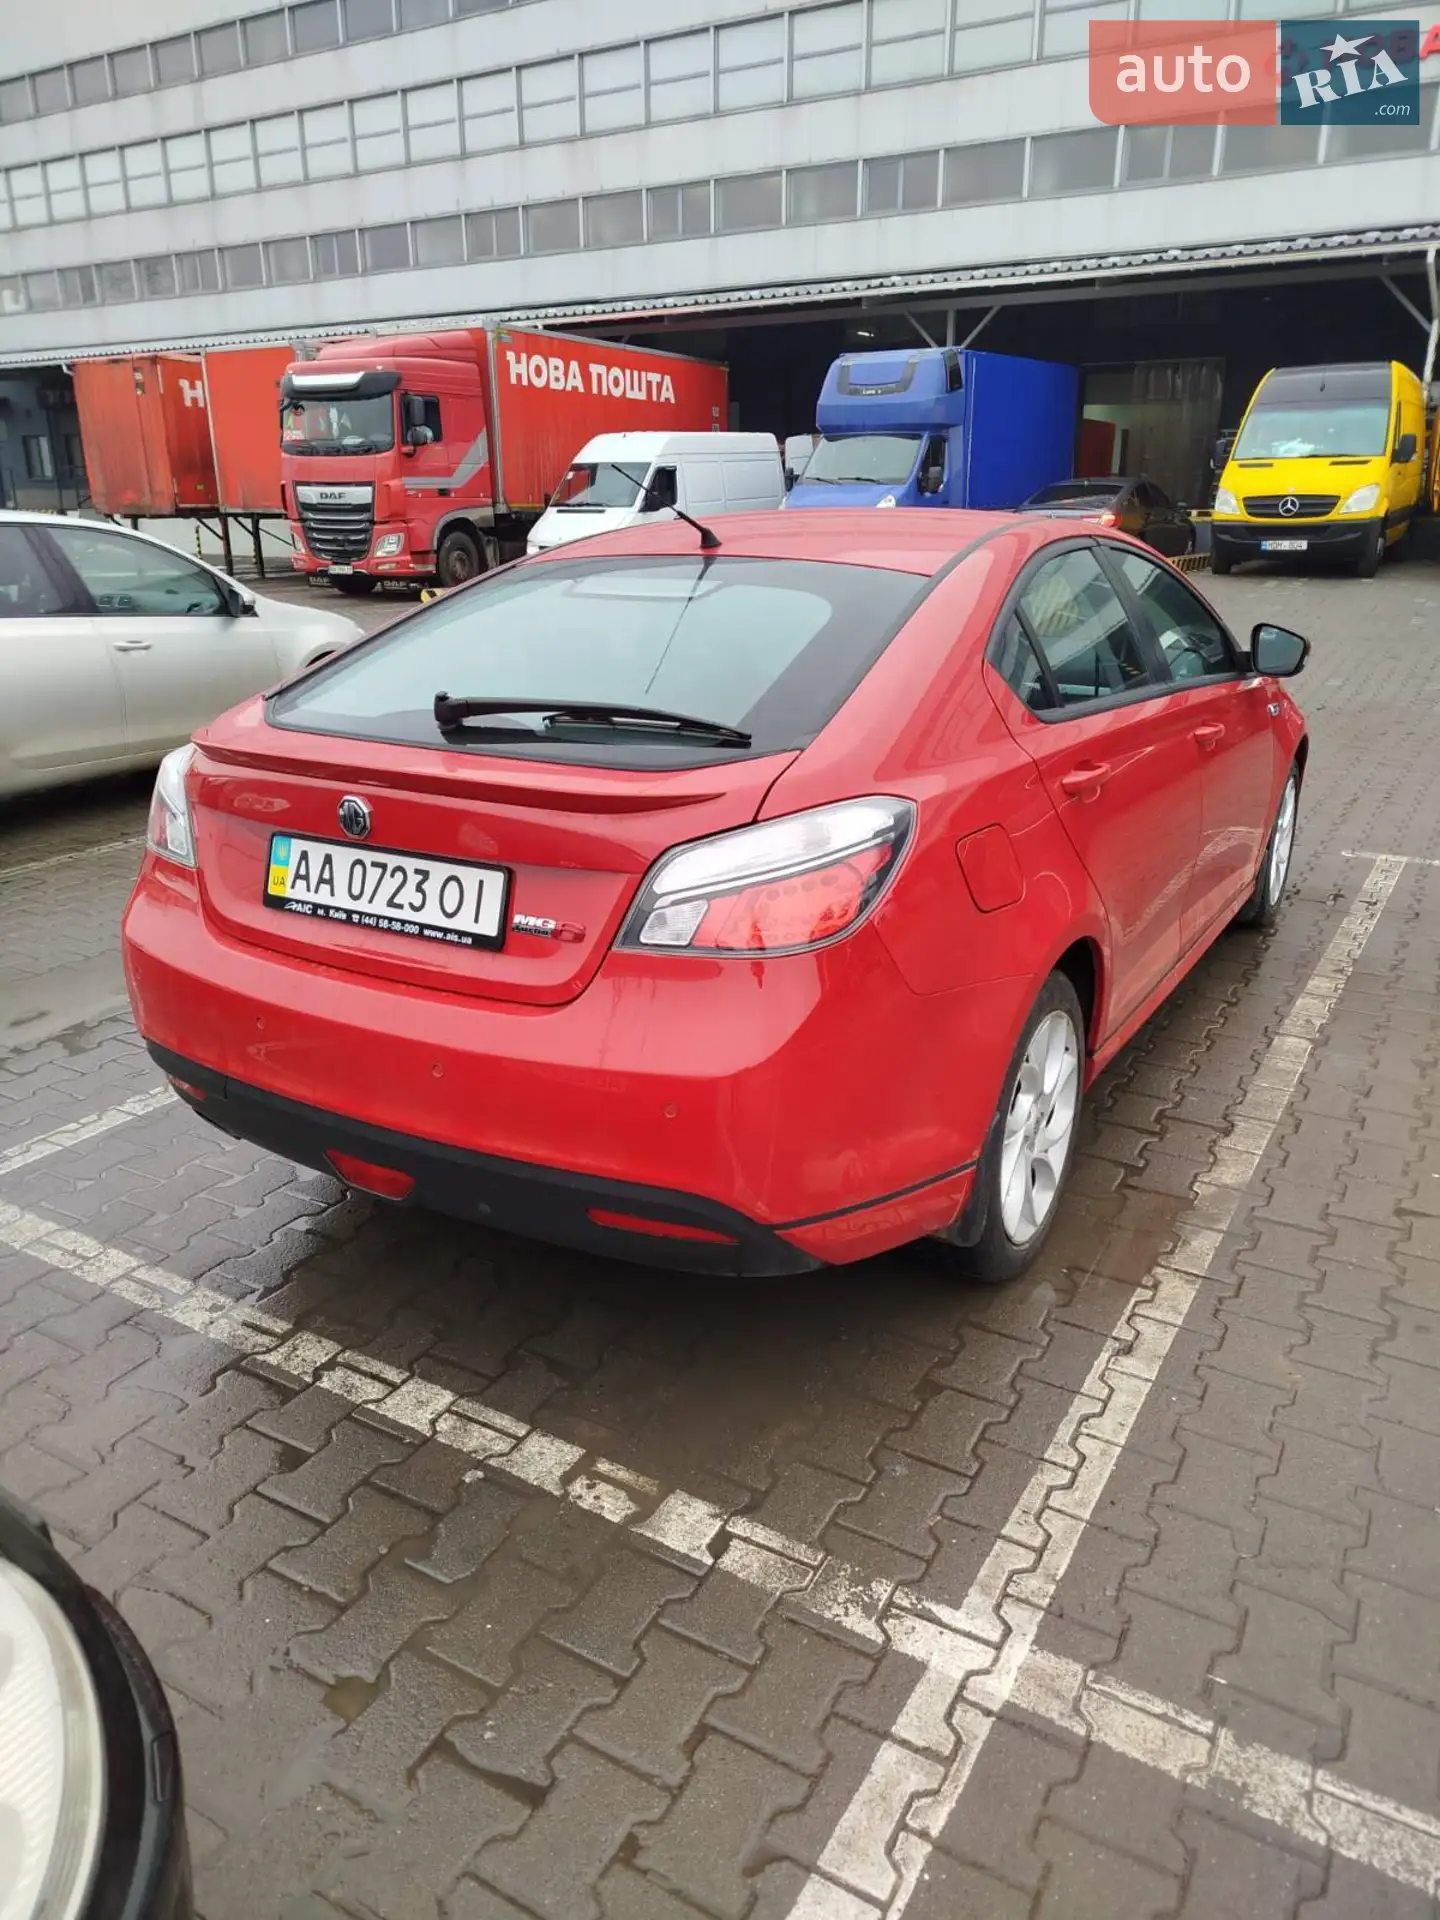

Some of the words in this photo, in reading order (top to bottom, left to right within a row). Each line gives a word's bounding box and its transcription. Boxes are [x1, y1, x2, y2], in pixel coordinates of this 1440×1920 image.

[506, 350, 585, 393] НОВА
[588, 362, 676, 404] ПОШТА
[319, 491, 347, 500] DAF
[272, 875, 285, 886] UA
[290, 849, 336, 898] AA
[347, 858, 430, 913] 0723
[361, 915, 377, 927] (44)
[423, 928, 473, 944] www.ais.ua
